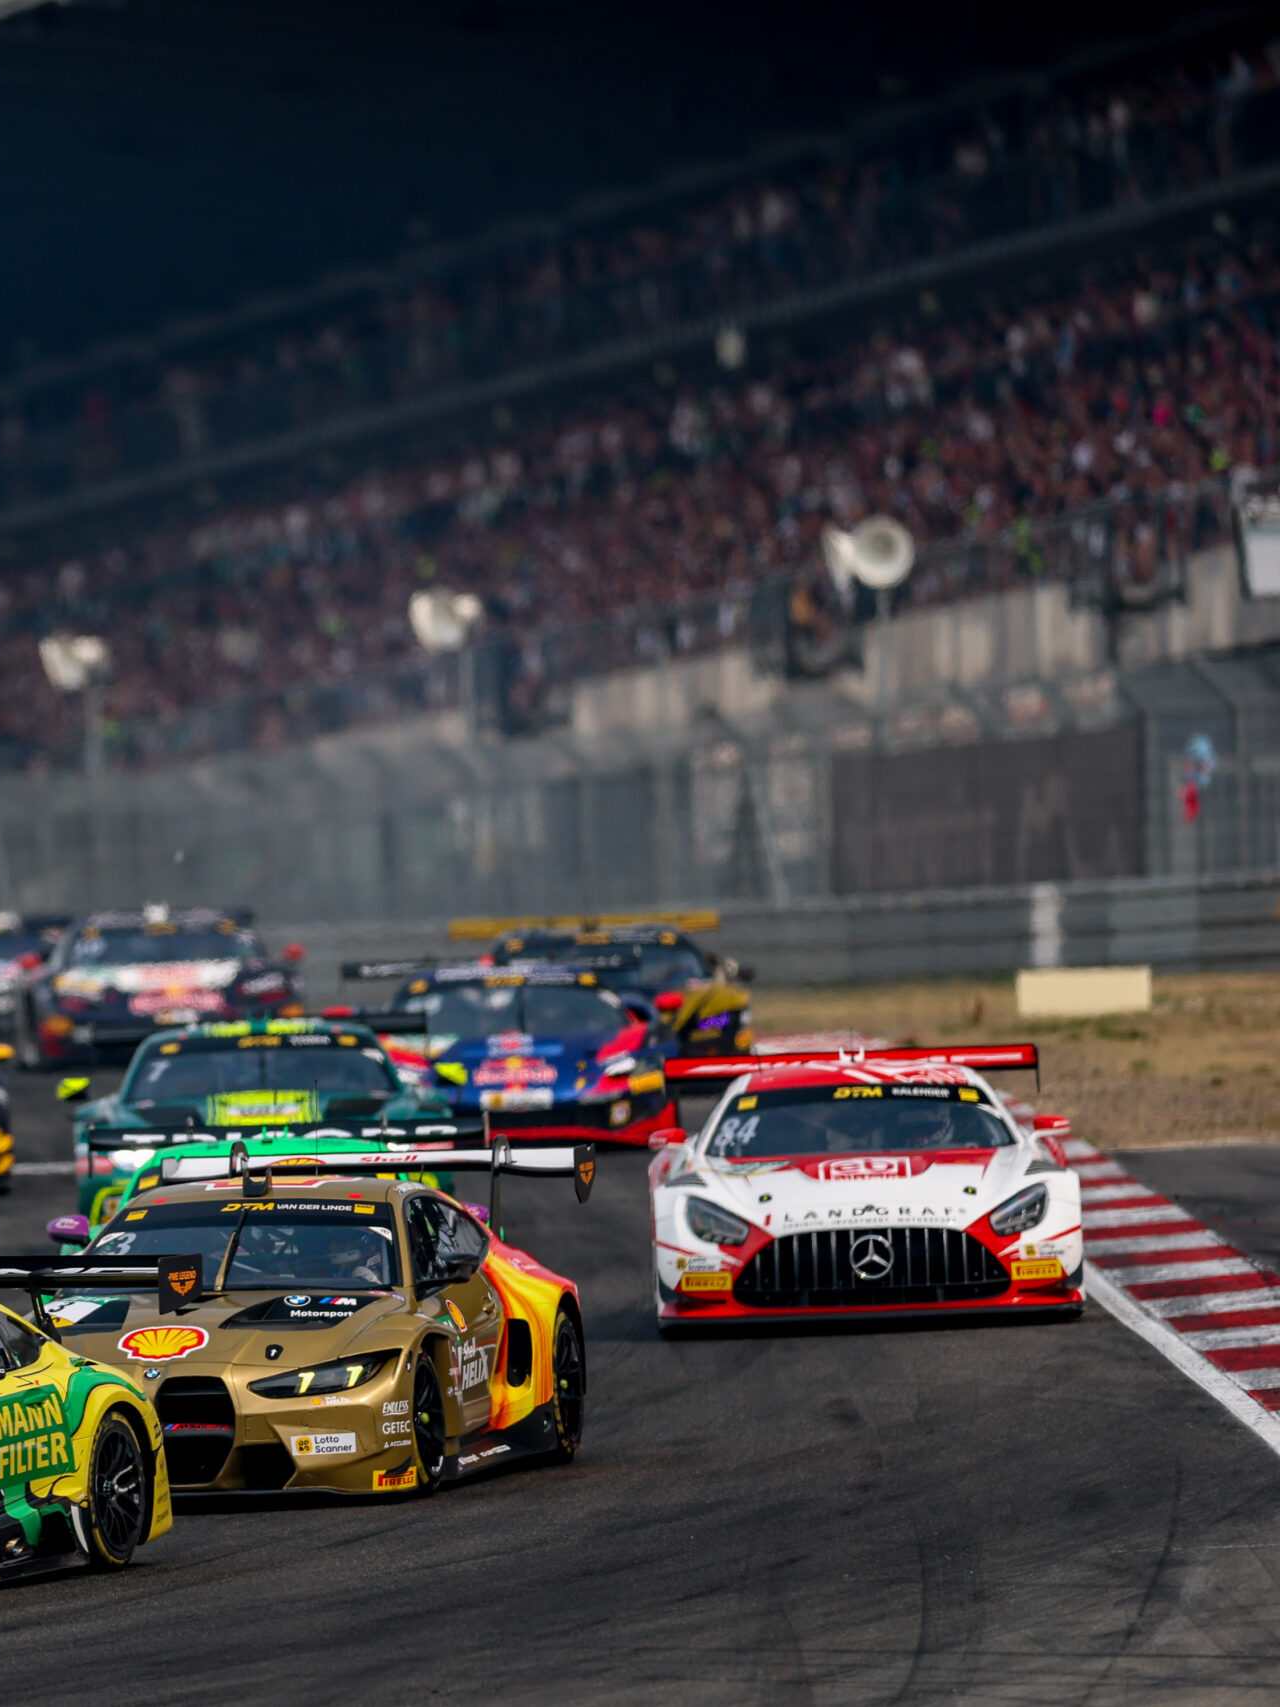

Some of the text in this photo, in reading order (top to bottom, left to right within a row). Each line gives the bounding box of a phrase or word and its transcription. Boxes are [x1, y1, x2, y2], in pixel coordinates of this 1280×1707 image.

[833, 1086, 883, 1099] DTM
[714, 1116, 760, 1146] 84
[360, 1155, 418, 1164] Shell
[221, 1203, 275, 1212] DTM
[276, 1203, 298, 1211] VAN
[321, 1204, 353, 1212] LINDE
[290, 1310, 354, 1318] Motorsport
[463, 1336, 476, 1361] Shell
[461, 1347, 489, 1391] HELIX
[382, 1400, 409, 1415] ENDLESS
[382, 1420, 412, 1434] GETEC
[314, 1436, 340, 1445] Lotto
[314, 1444, 353, 1454] Scanner
[377, 1470, 414, 1487] PIRELLI
